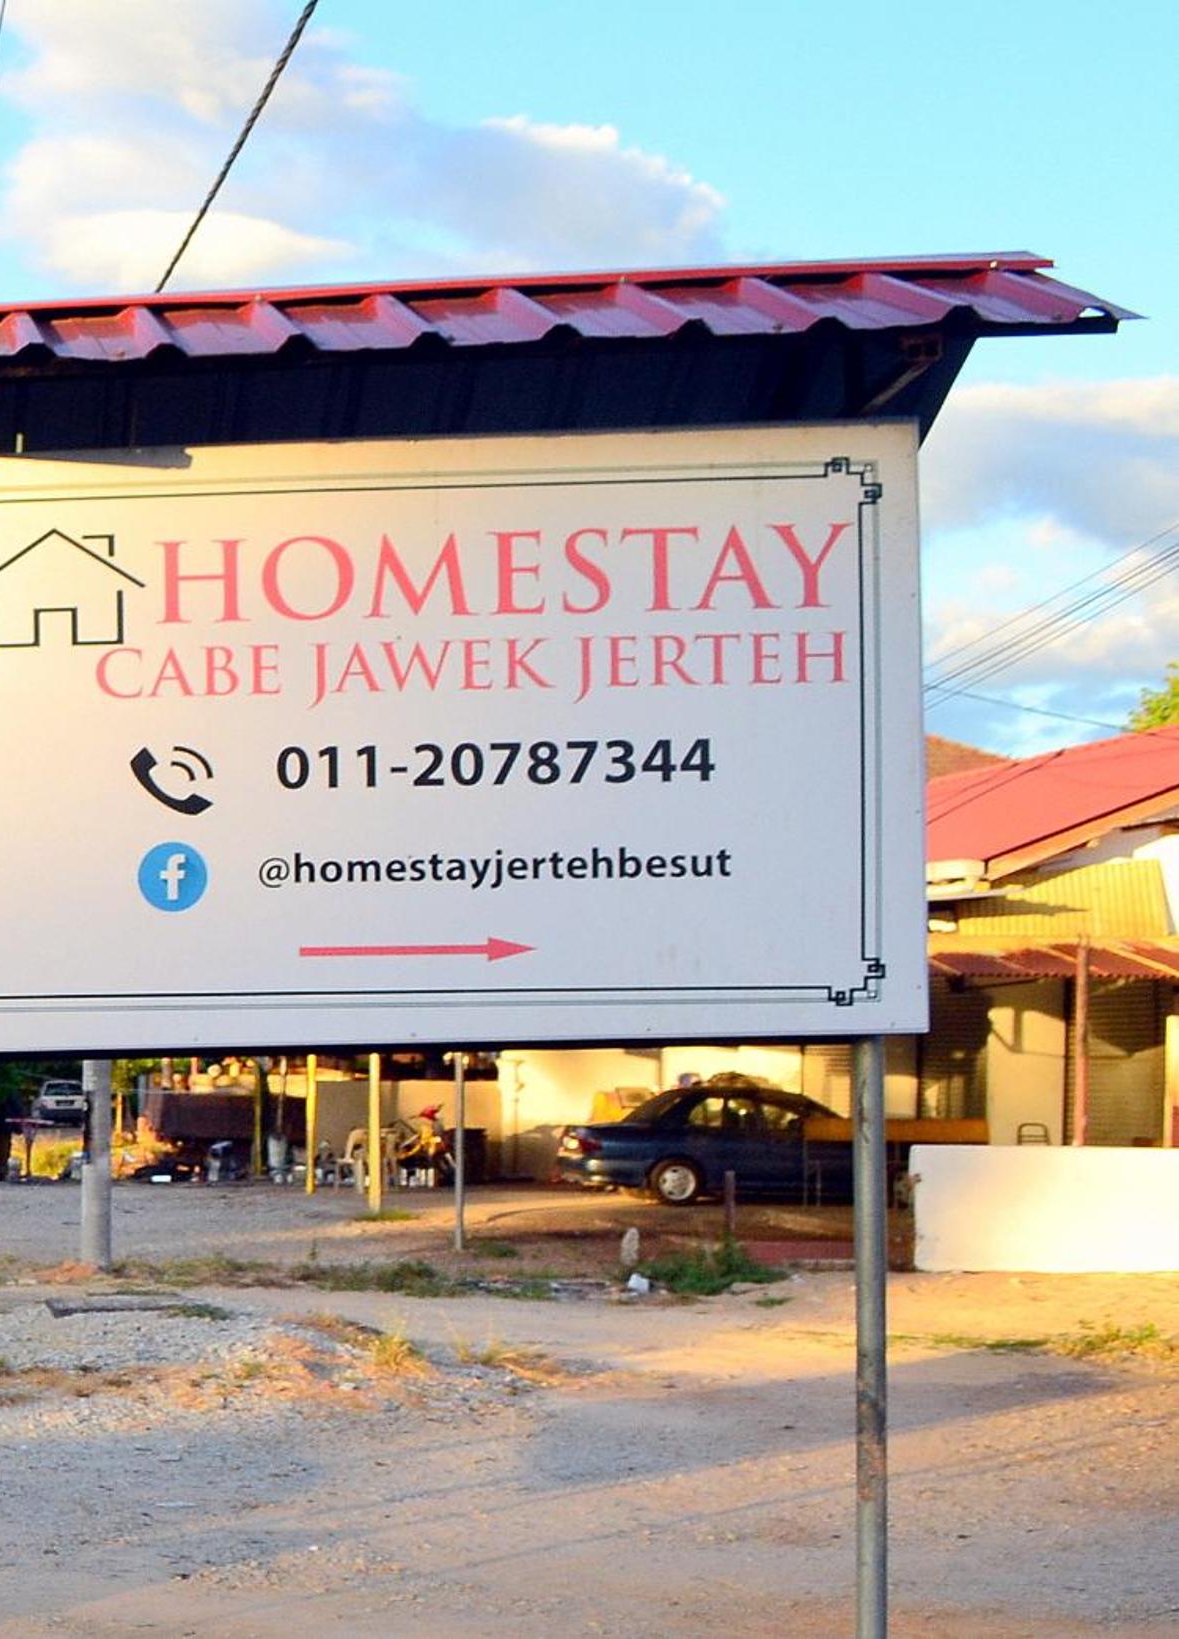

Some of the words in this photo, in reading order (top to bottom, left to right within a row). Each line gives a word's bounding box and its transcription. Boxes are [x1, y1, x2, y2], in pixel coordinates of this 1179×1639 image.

[153, 523, 854, 624] HOMESTAY
[95, 645, 281, 699] CABE
[307, 637, 556, 710] JAWEK
[574, 630, 849, 704] JERTEH
[276, 738, 716, 790] 011-20787344
[259, 847, 732, 890] @homestayjertehbesut
